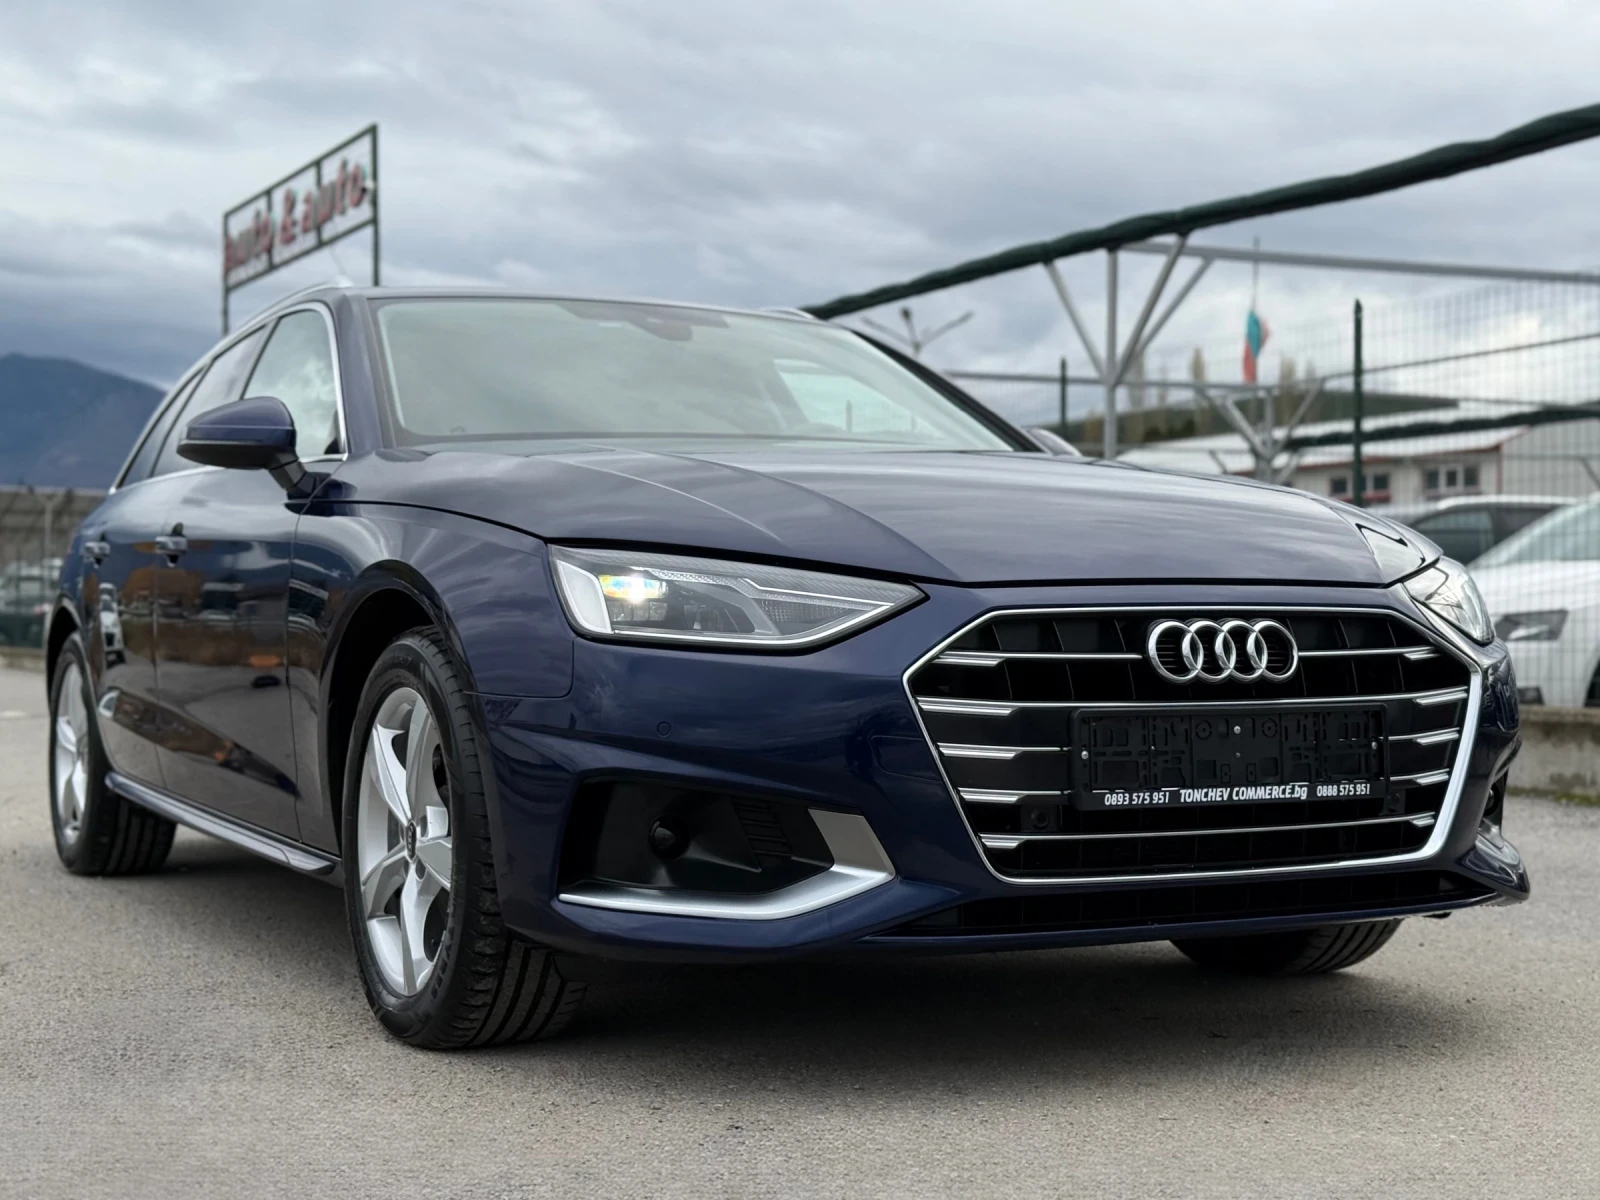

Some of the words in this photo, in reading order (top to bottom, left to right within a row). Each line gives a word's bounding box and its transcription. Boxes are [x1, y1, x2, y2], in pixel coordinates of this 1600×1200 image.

[1104, 793, 1130, 806] 0893
[1131, 792, 1151, 805] 575
[1152, 791, 1170, 804] 951
[1179, 787, 1231, 803] TONCHEV
[1232, 784, 1309, 801] COMMERCE.bg
[1316, 784, 1338, 797] 0888
[1339, 784, 1355, 796] 575
[1355, 783, 1371, 795] 951
